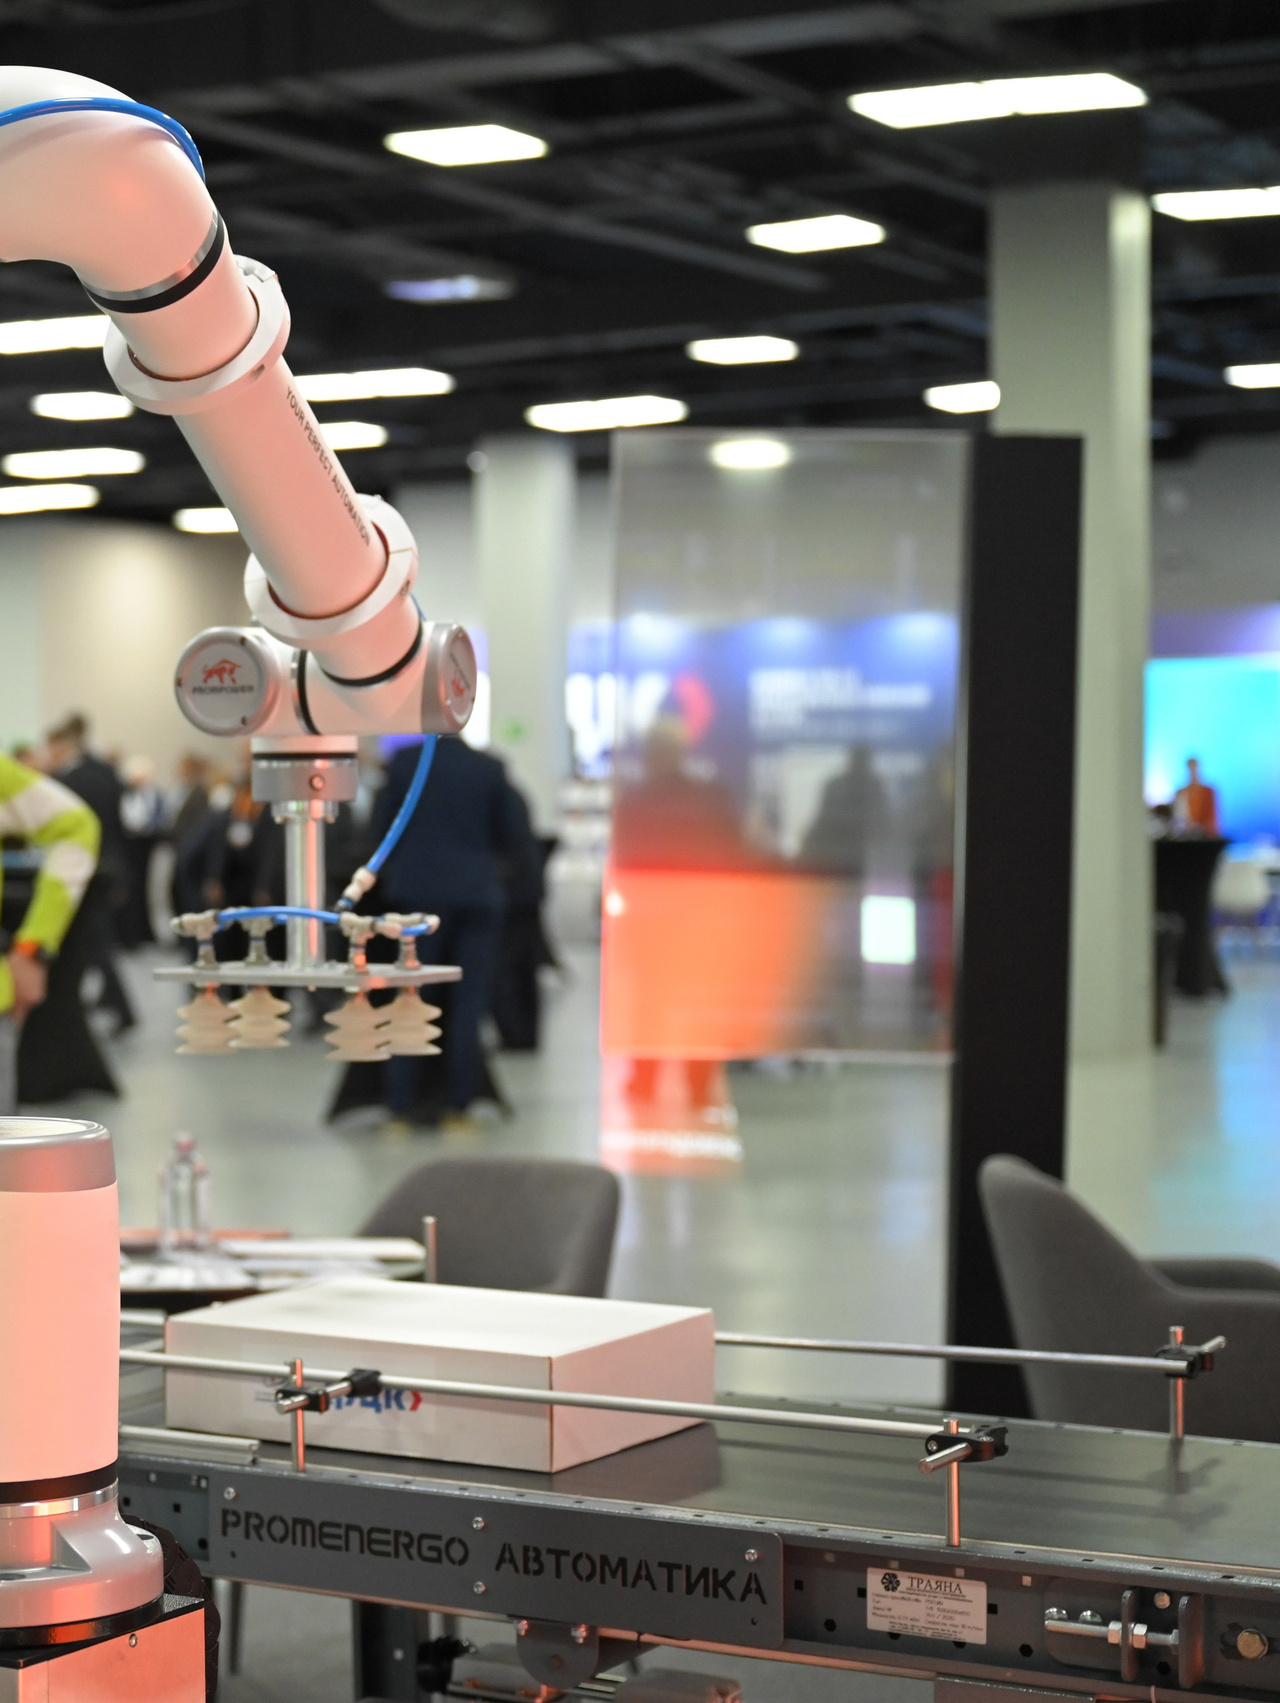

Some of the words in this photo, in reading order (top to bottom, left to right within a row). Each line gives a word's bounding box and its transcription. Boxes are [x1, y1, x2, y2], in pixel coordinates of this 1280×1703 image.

[287, 384, 305, 426] YOUR
[304, 420, 333, 476] PERFECT
[332, 473, 371, 548] AUTOMATION
[221, 1508, 470, 1567] PROMENERGO
[494, 1541, 768, 1605] АВТОМАТИКА
[908, 1576, 963, 1594] ТРАЯНА
